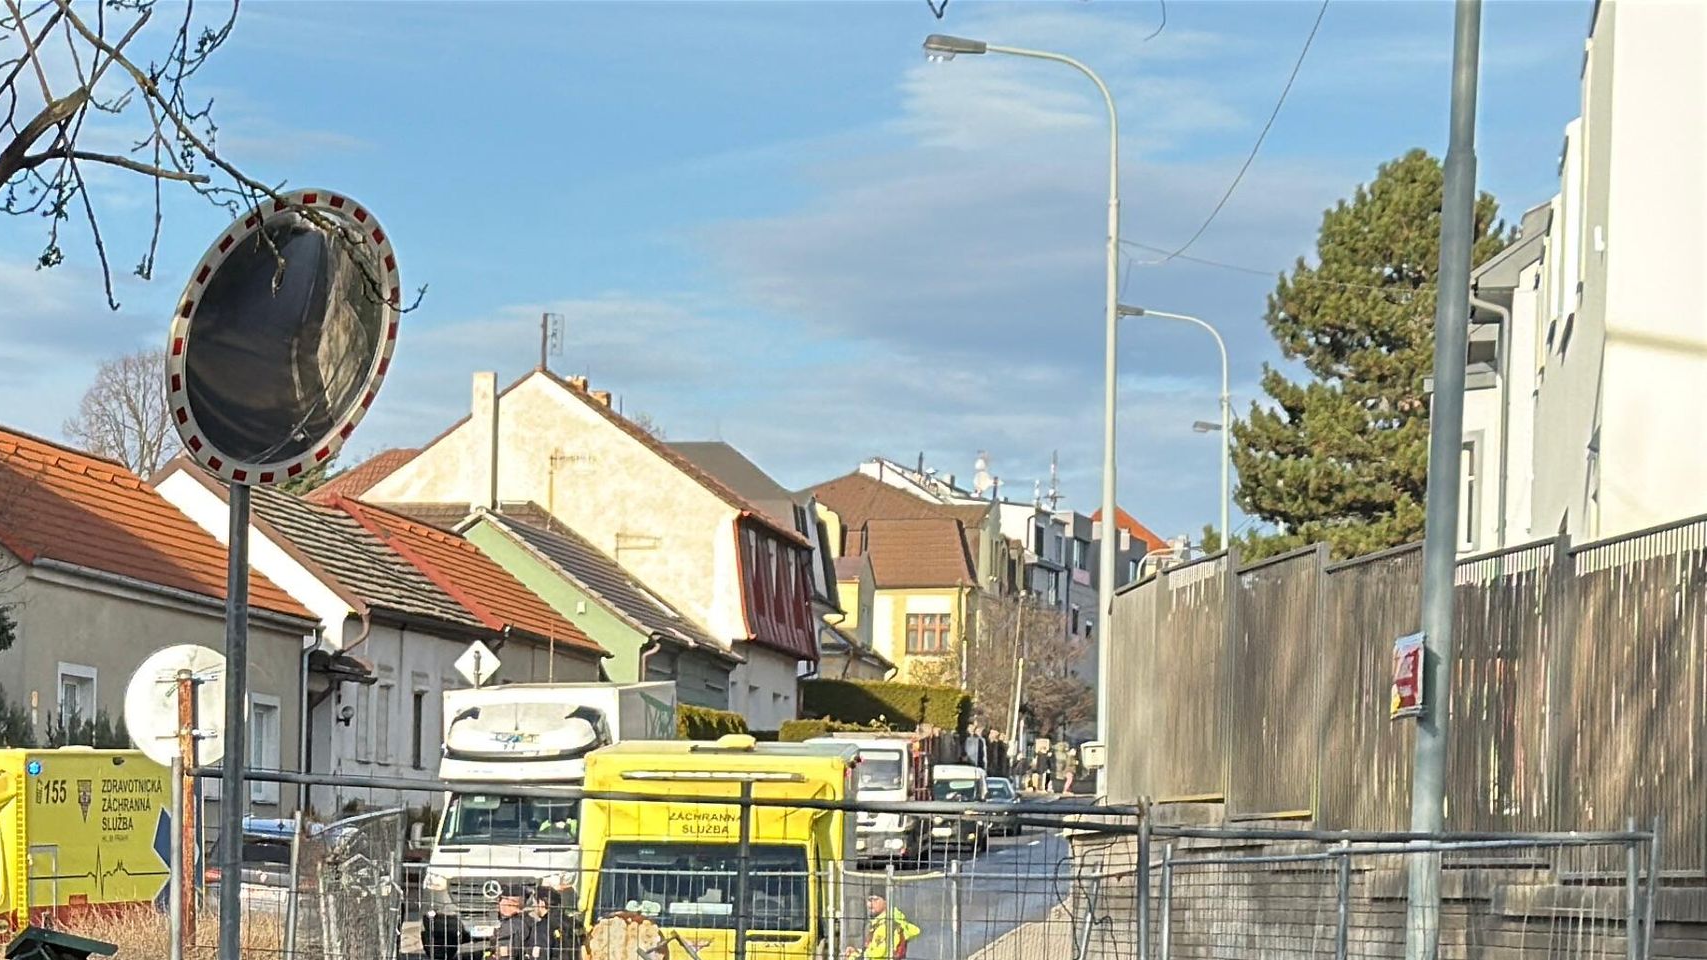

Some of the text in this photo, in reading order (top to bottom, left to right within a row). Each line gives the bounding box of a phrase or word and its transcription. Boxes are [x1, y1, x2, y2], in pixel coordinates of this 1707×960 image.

[44, 780, 67, 804] 155
[102, 776, 162, 793] ZDRAVOTNICKÁ
[102, 794, 151, 812] ZÁCHRANNÁ
[102, 813, 133, 831] SLUŽBA
